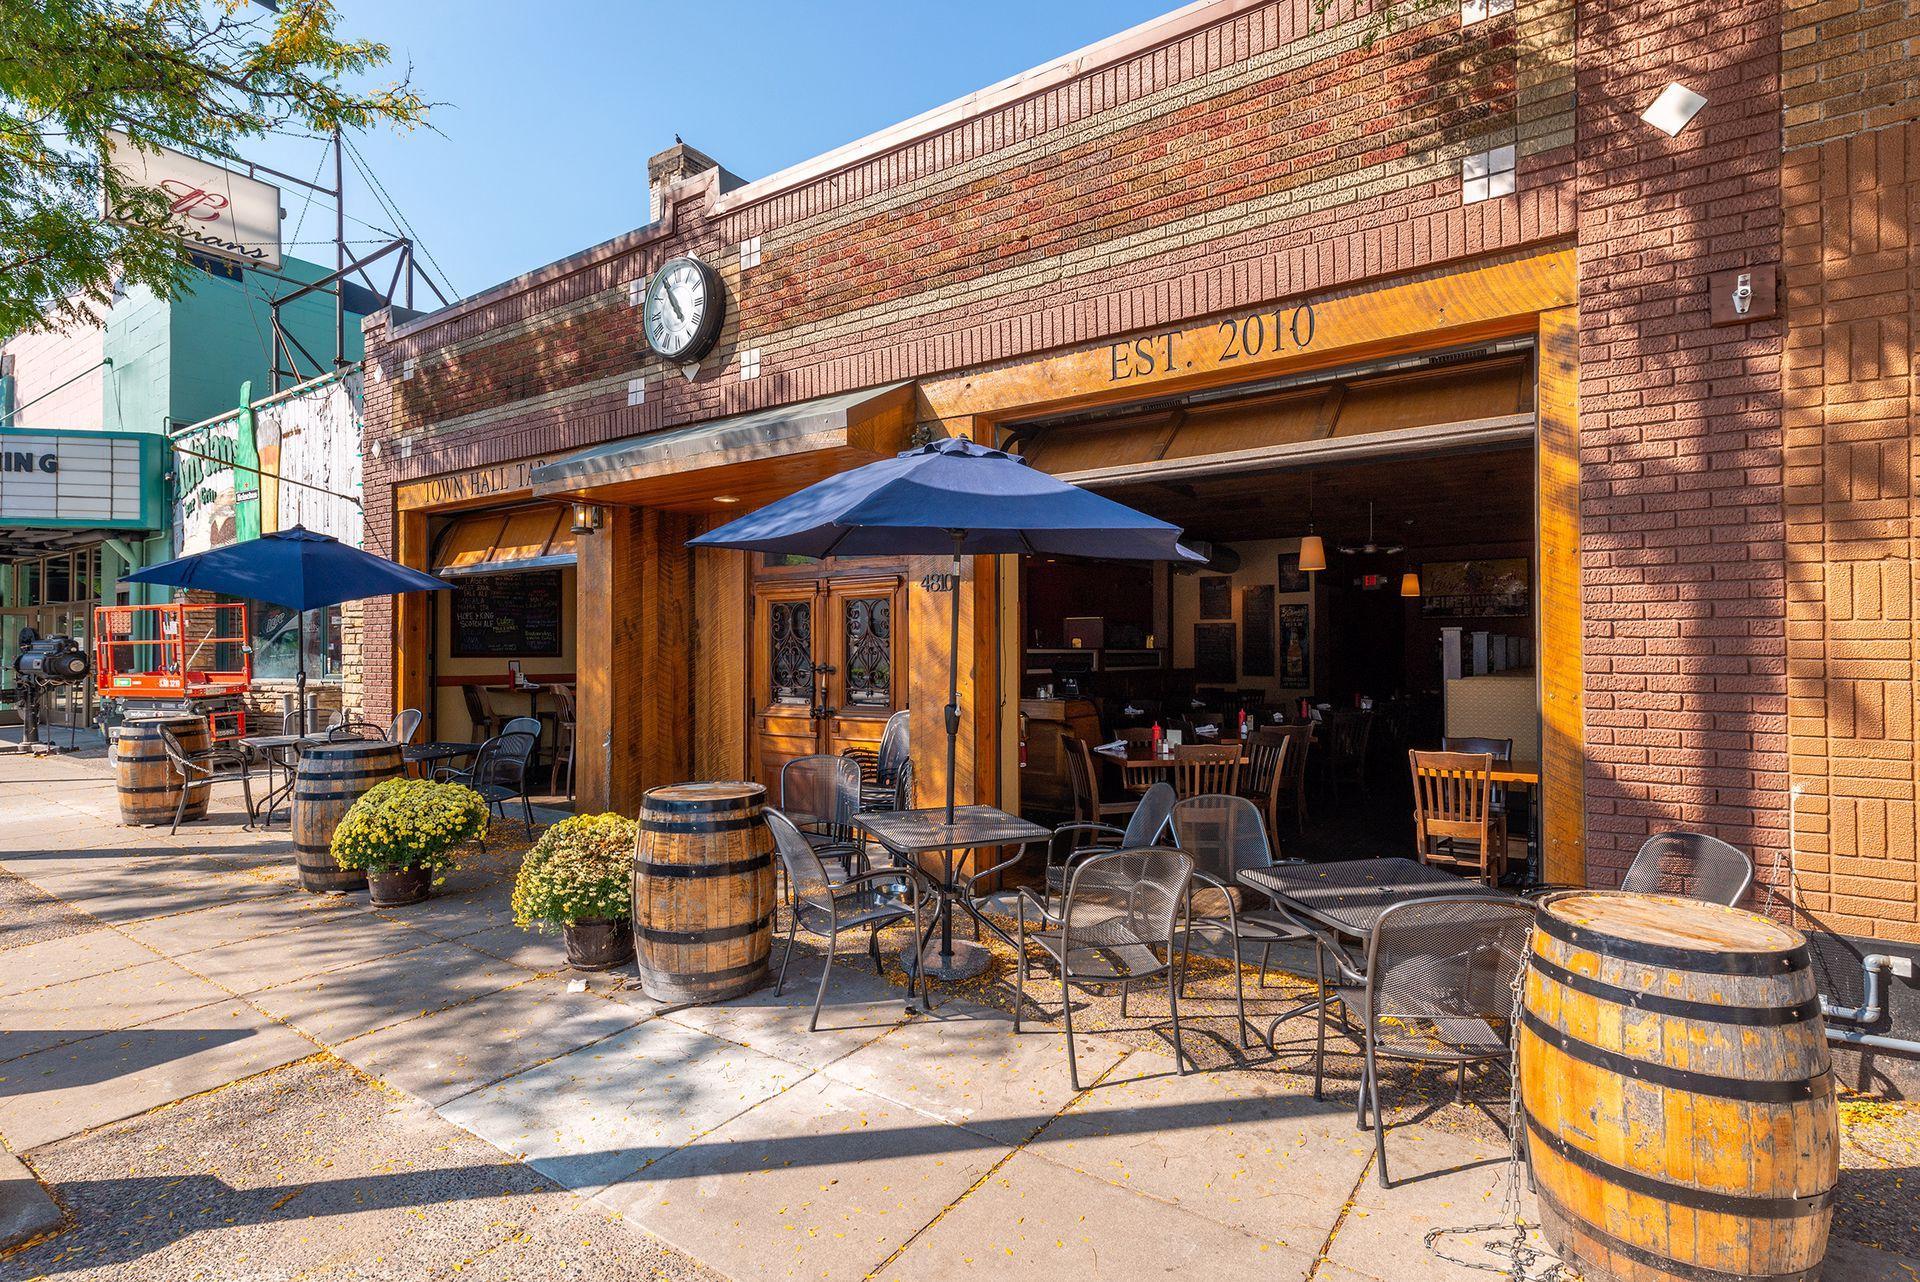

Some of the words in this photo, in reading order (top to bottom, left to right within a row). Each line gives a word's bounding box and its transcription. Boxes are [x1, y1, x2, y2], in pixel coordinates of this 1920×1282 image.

[1109, 330, 1193, 382] EST.
[1218, 303, 1315, 362] 2010
[0, 451, 57, 473] ING
[424, 475, 463, 503] TOWN
[470, 467, 509, 496] HALL
[921, 573, 953, 592] 4810
